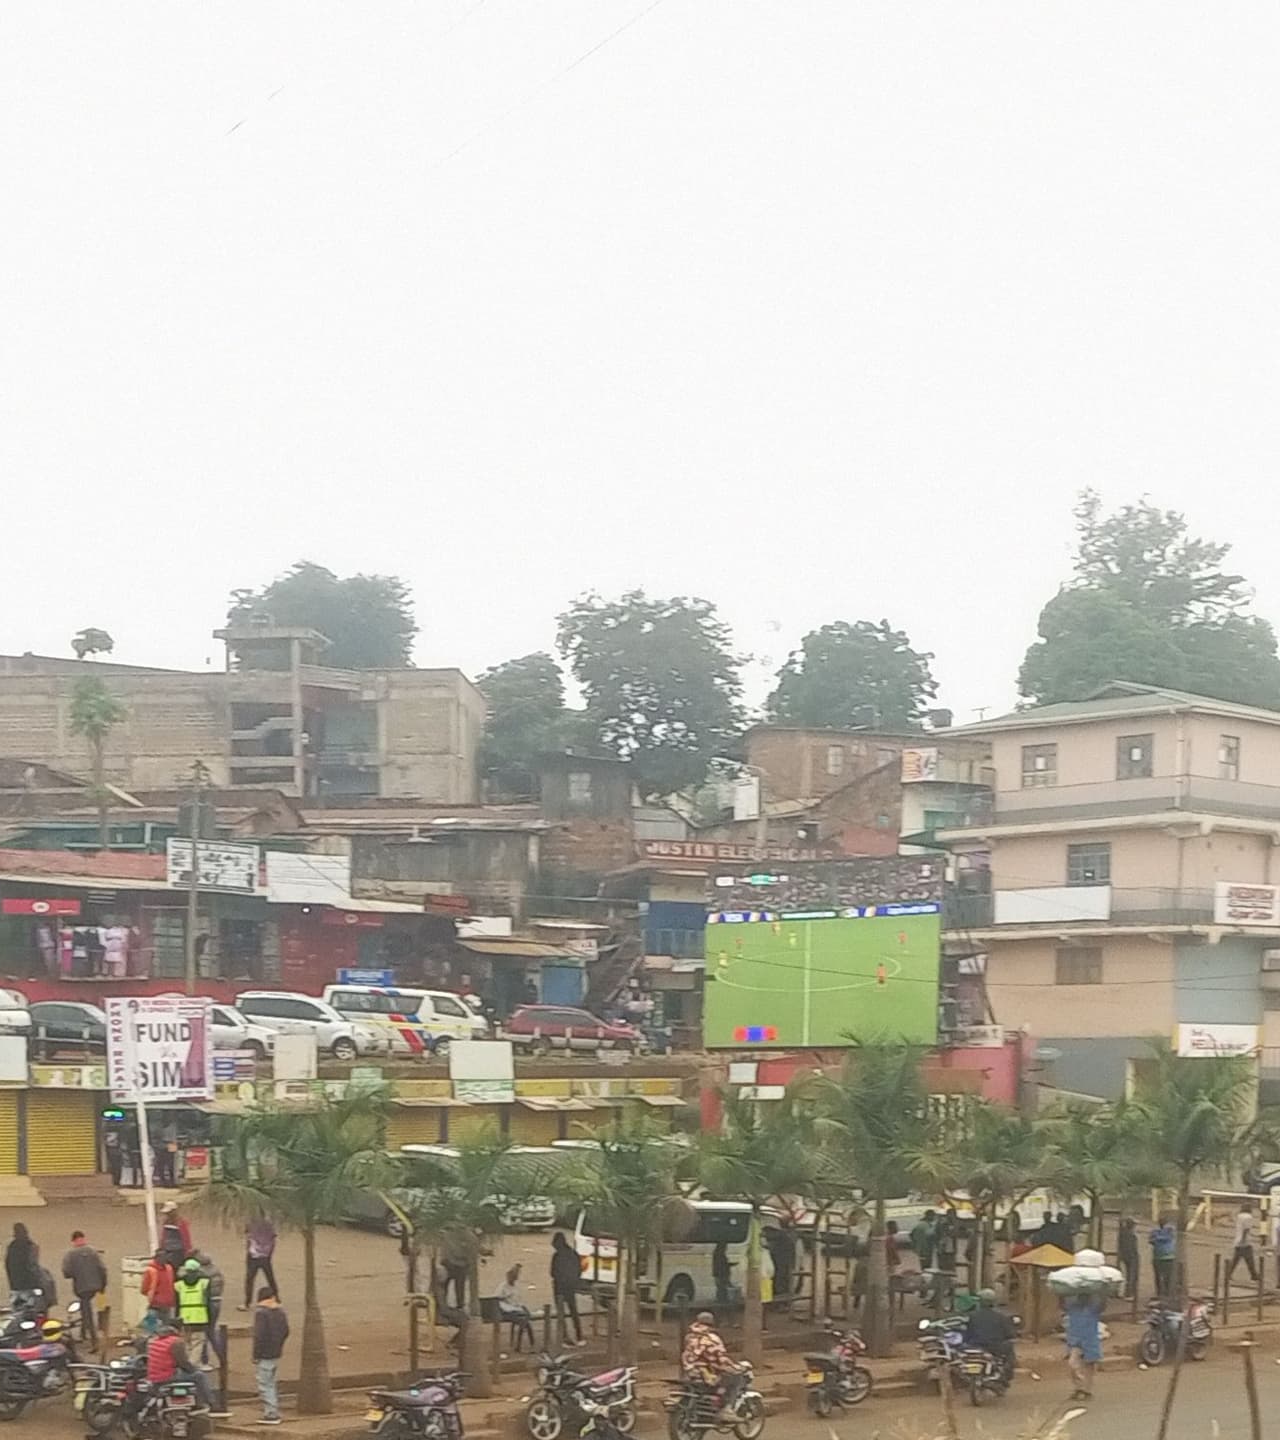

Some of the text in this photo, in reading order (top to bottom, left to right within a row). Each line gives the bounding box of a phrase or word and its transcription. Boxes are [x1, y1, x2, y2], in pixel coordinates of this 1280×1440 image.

[646, 841, 715, 857] JUSTIN
[110, 1002, 124, 1042] PHONE
[112, 1050, 127, 1098] REPAIR
